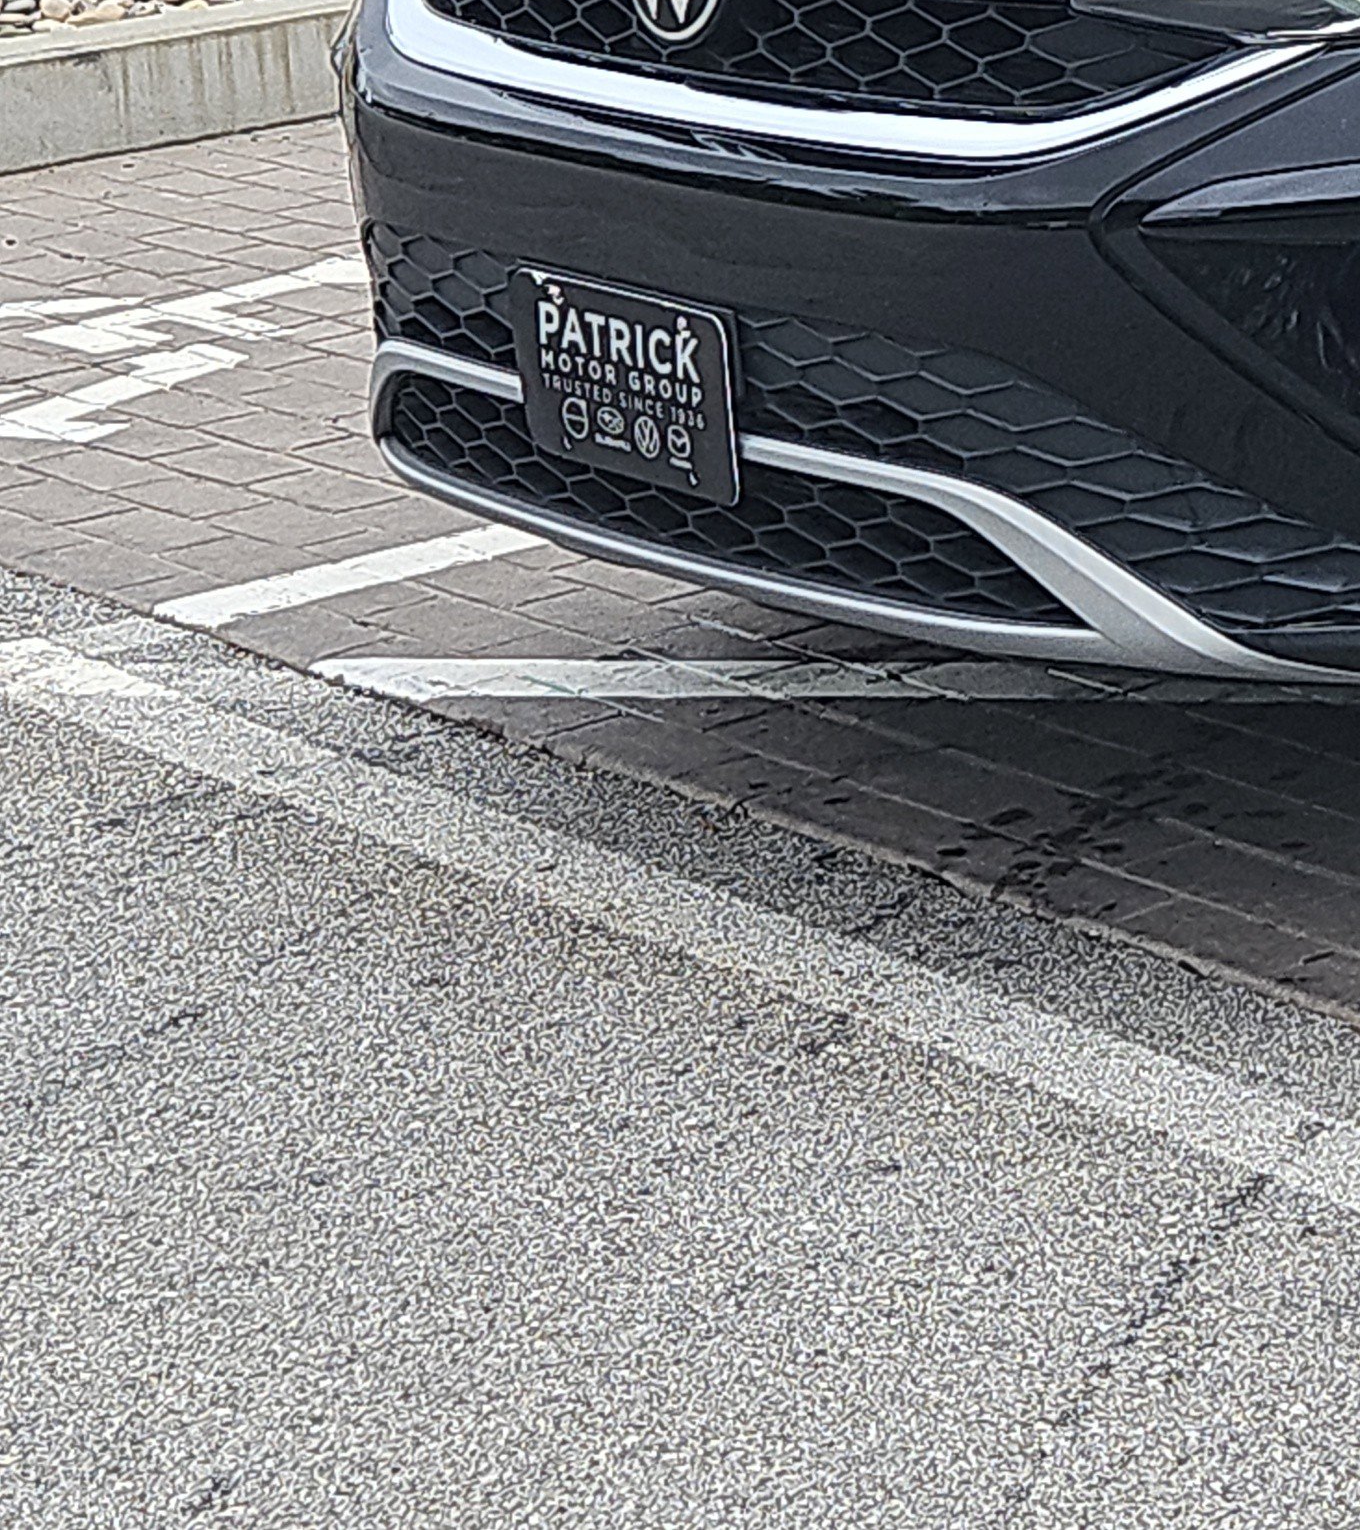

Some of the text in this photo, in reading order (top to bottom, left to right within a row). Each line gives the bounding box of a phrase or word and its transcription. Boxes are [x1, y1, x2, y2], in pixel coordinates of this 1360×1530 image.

[537, 300, 700, 383] PATRICK
[541, 348, 703, 408] MOTOR GROUP
[542, 372, 612, 404] TRUSTED
[618, 391, 664, 419] SINCE
